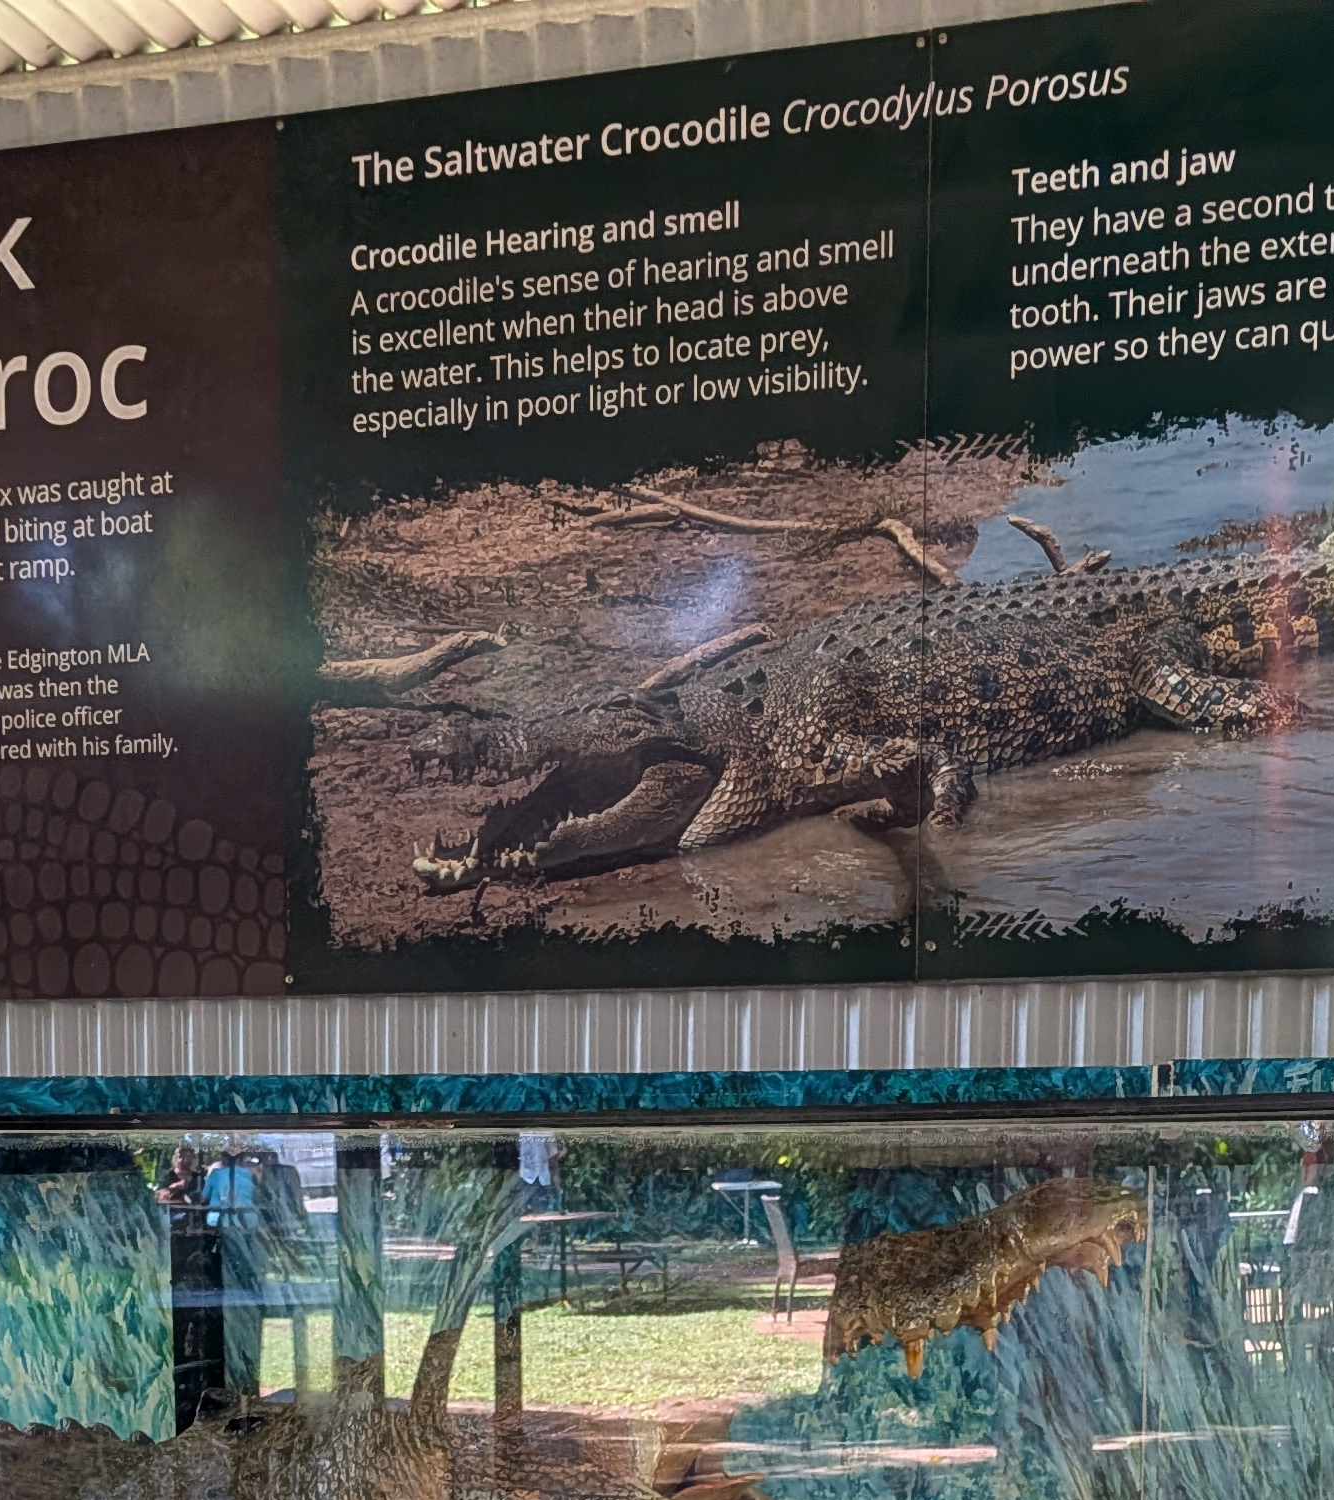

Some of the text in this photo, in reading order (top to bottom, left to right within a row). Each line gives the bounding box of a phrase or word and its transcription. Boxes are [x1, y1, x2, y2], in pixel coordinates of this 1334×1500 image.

[351, 65, 1130, 187] The Saltwater Crocodile Crocodylus Porosus
[1011, 147, 1236, 196] Teeth and jaw
[350, 200, 740, 271] Crocodile Hearing and smell
[1010, 213, 1085, 248] They
[1093, 206, 1165, 237] have
[1174, 204, 1192, 227] a
[1201, 182, 1314, 224] second
[350, 229, 894, 317] A crocodile's sense of hearing and smell
[1012, 240, 1190, 287] underneath
[1199, 235, 1251, 267] the
[352, 282, 849, 356] is excellent when their head is above
[16, 483, 62, 505] was
[67, 471, 145, 505] caught
[150, 470, 174, 495] at
[4, 516, 68, 547] biting
[72, 514, 96, 539] at
[100, 510, 154, 536] boat
[9, 557, 76, 585] ramp.
[7, 647, 102, 674] Edgington
[107, 642, 151, 664] MLA
[38, 677, 82, 698] then
[86, 674, 119, 696] the
[35, 736, 77, 759] with
[82, 735, 110, 757] his
[114, 732, 179, 759] family.
